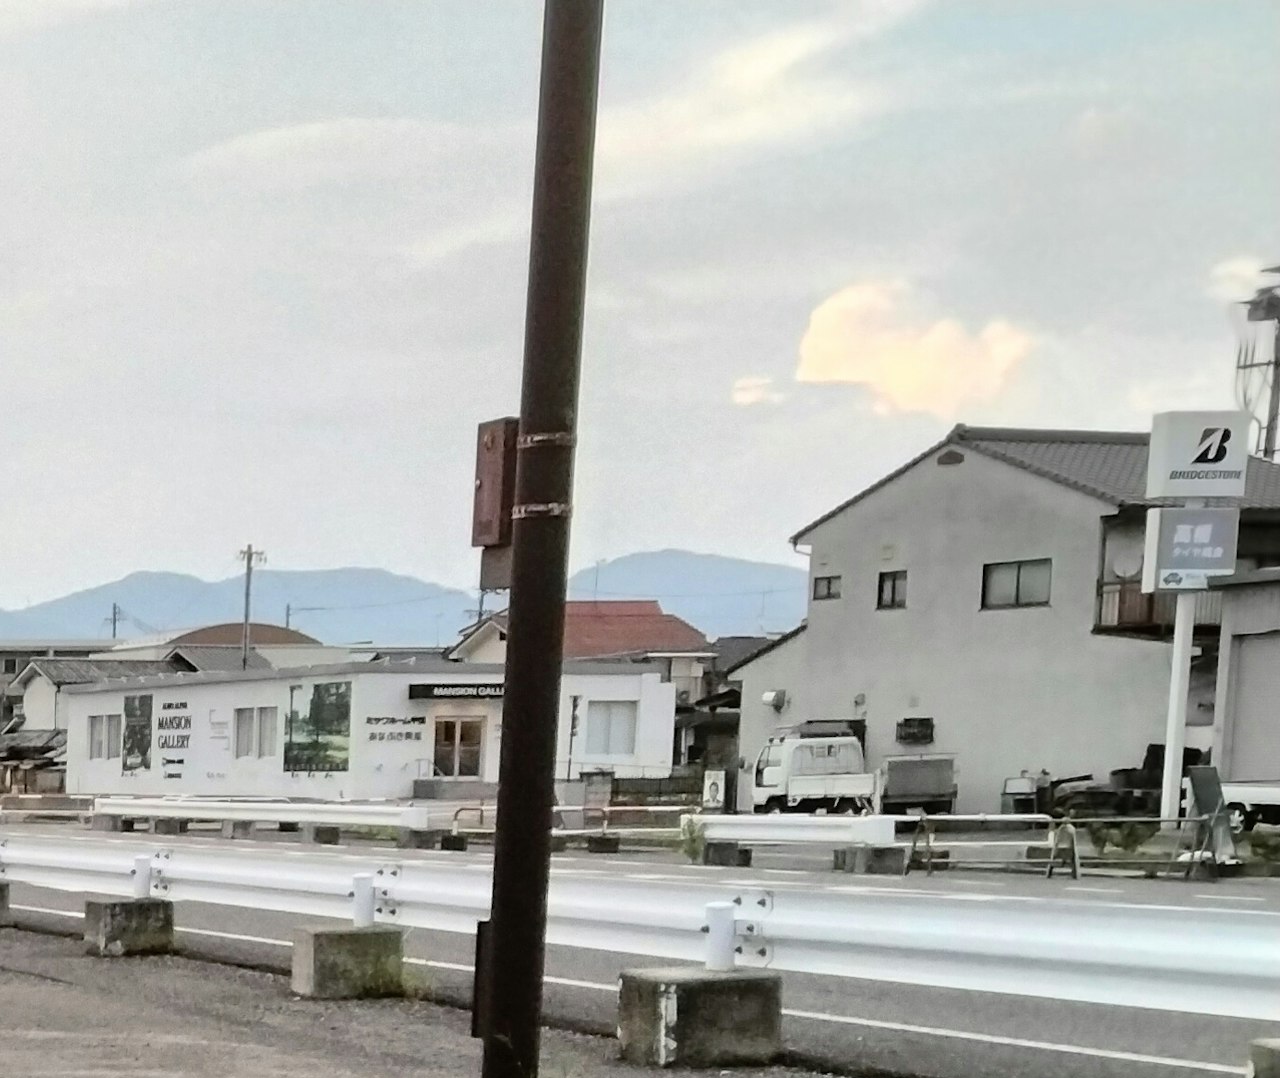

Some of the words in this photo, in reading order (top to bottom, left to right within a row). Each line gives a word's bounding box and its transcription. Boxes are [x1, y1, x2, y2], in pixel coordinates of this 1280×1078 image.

[433, 686, 477, 696] MANSION
[158, 715, 192, 730] MANSION
[158, 734, 191, 749] GALLERY
